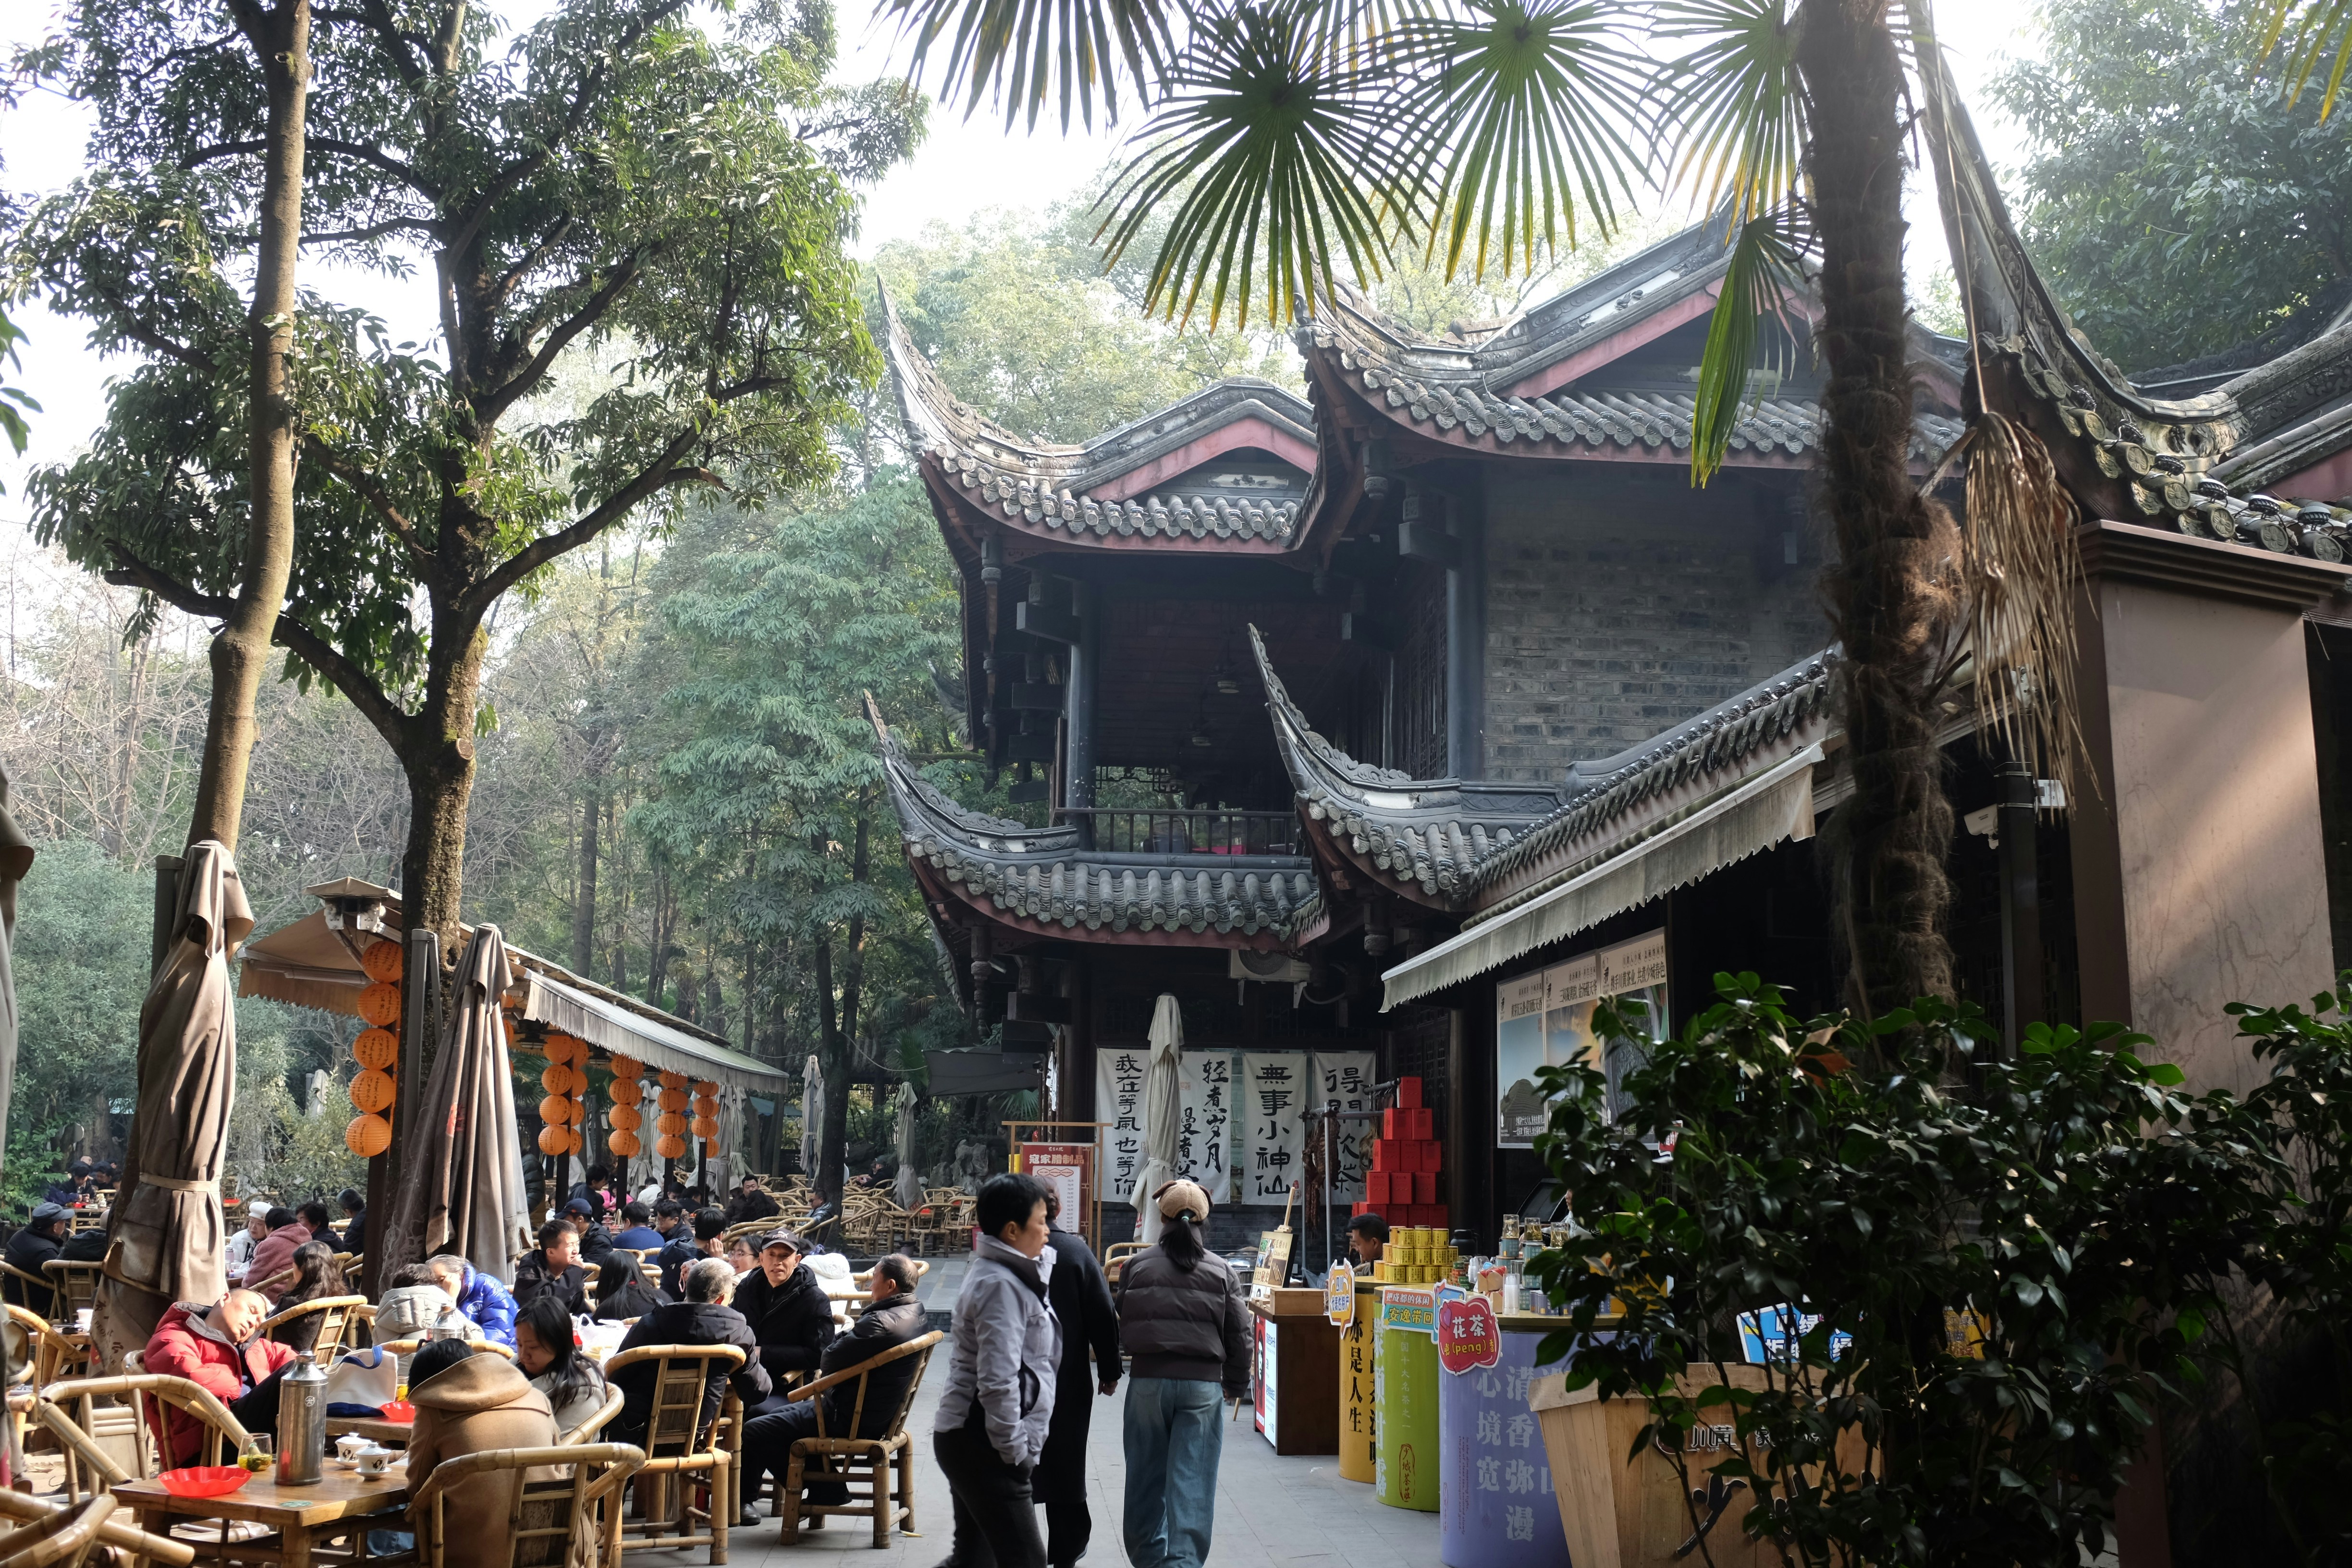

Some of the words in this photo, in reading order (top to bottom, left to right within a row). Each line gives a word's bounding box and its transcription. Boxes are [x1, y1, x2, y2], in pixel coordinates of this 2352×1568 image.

[1029, 1154, 1084, 1164] 寇家腊制品
[1386, 1292, 1430, 1305] 把成都的休闲
[1388, 1308, 1433, 1325] 安逸带回
[1452, 1314, 1485, 1339] 花茶
